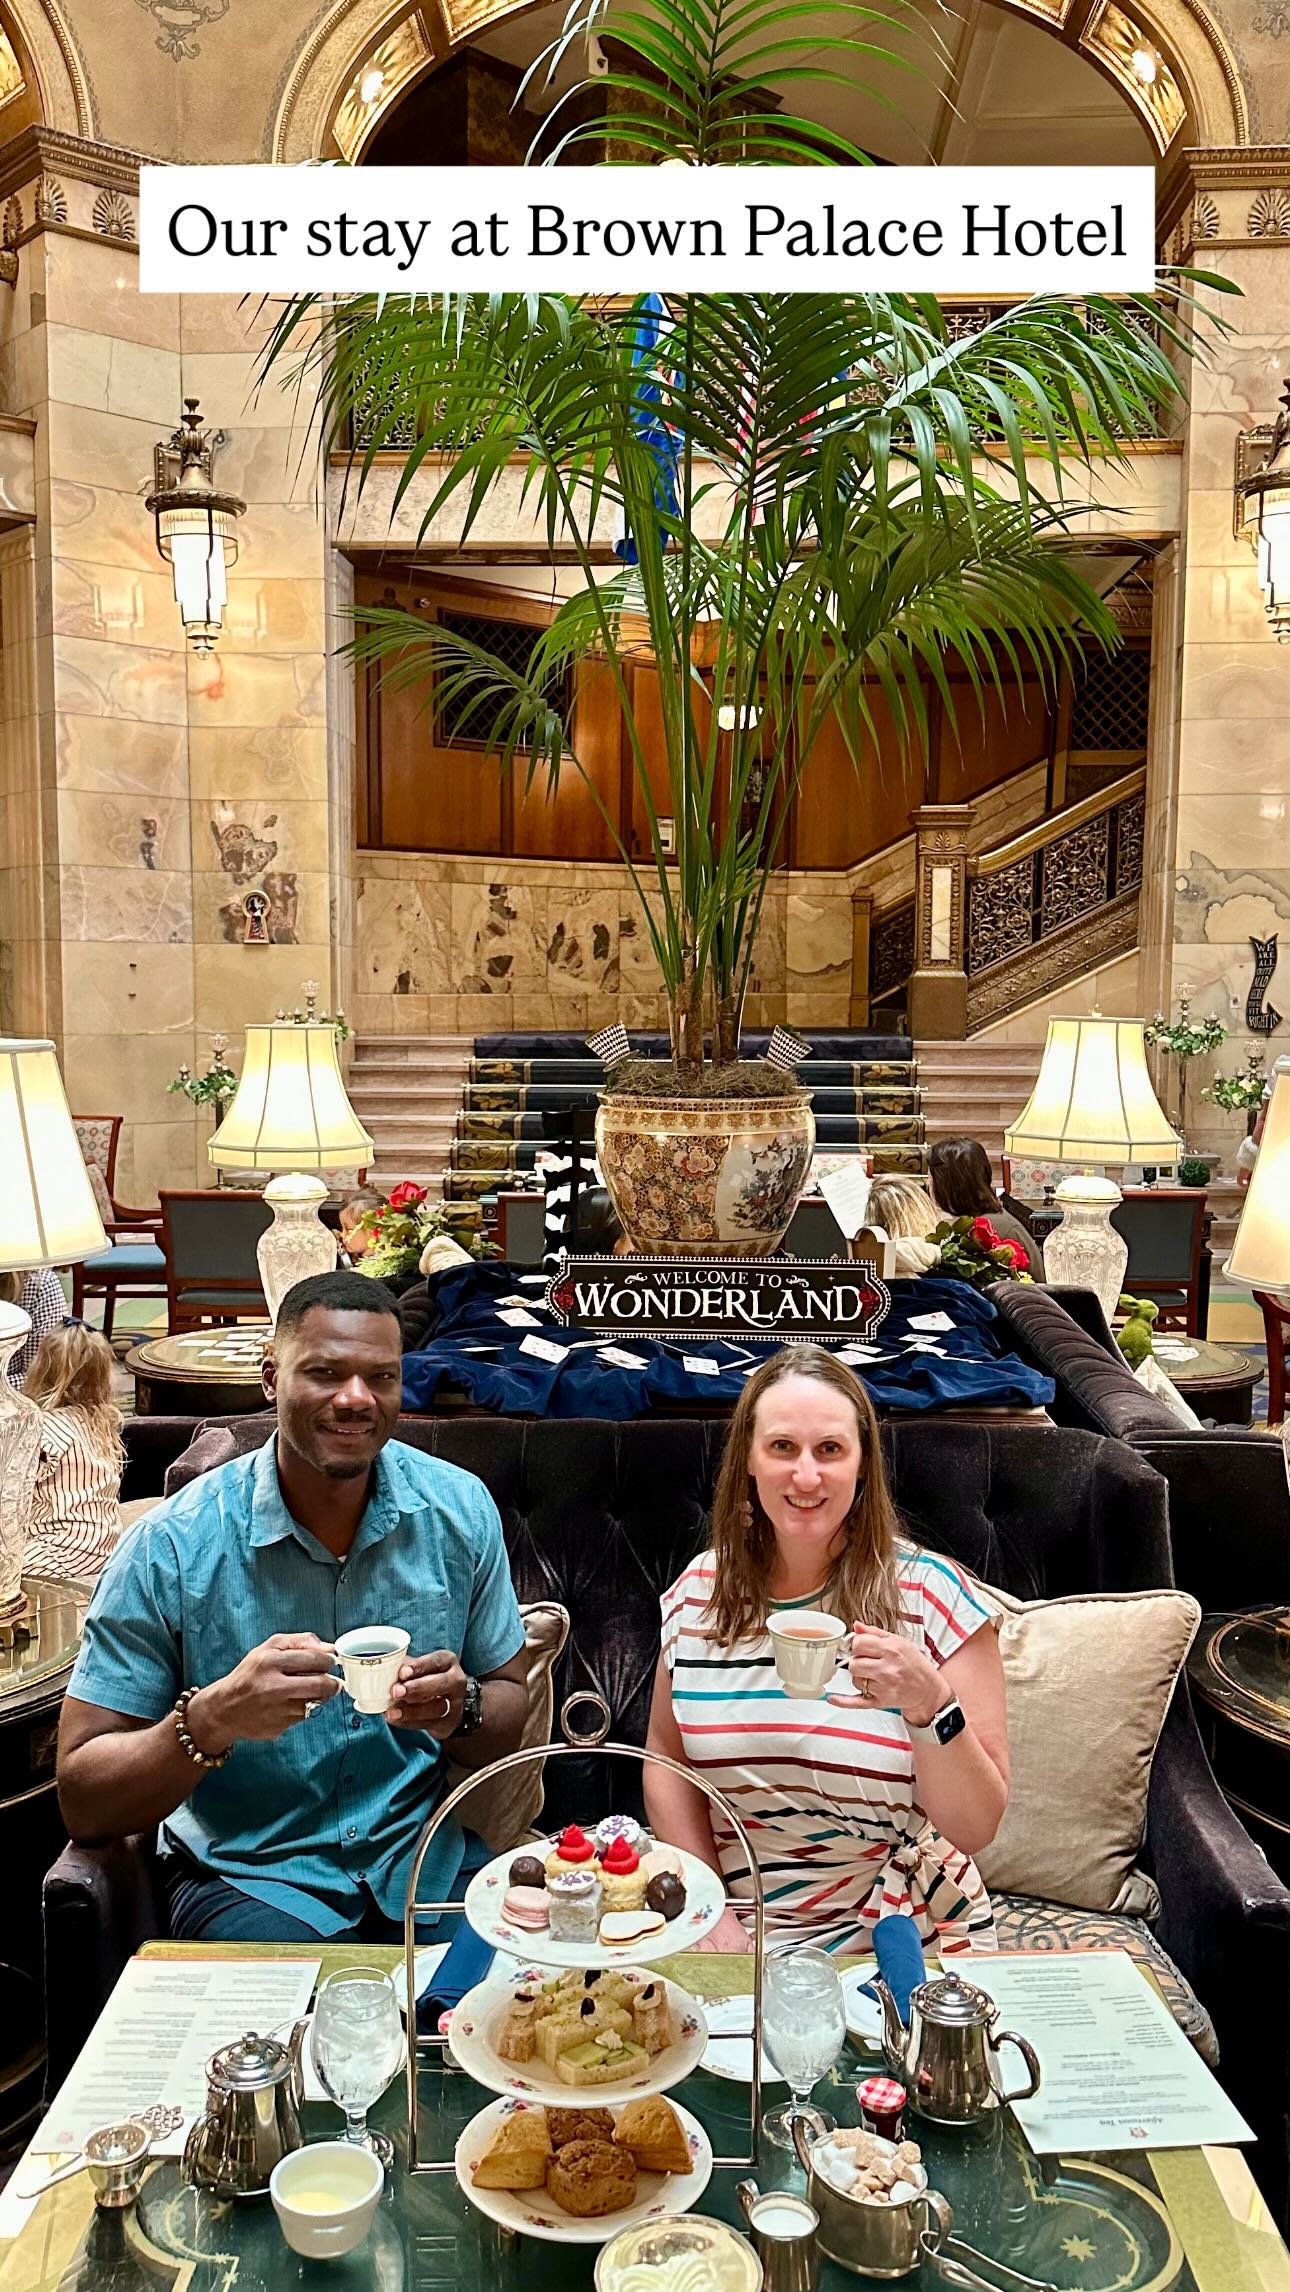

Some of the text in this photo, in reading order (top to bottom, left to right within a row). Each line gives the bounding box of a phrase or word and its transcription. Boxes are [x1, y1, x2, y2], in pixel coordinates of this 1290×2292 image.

[1253, 940, 1275, 951] WE
[1258, 959, 1275, 967] ALL
[1248, 1007, 1260, 1015] FIT
[1248, 1013, 1279, 1029] RIGHT IN
[651, 1270, 782, 1288] WELCOME TO
[574, 1282, 863, 1328] WONDERLAND
